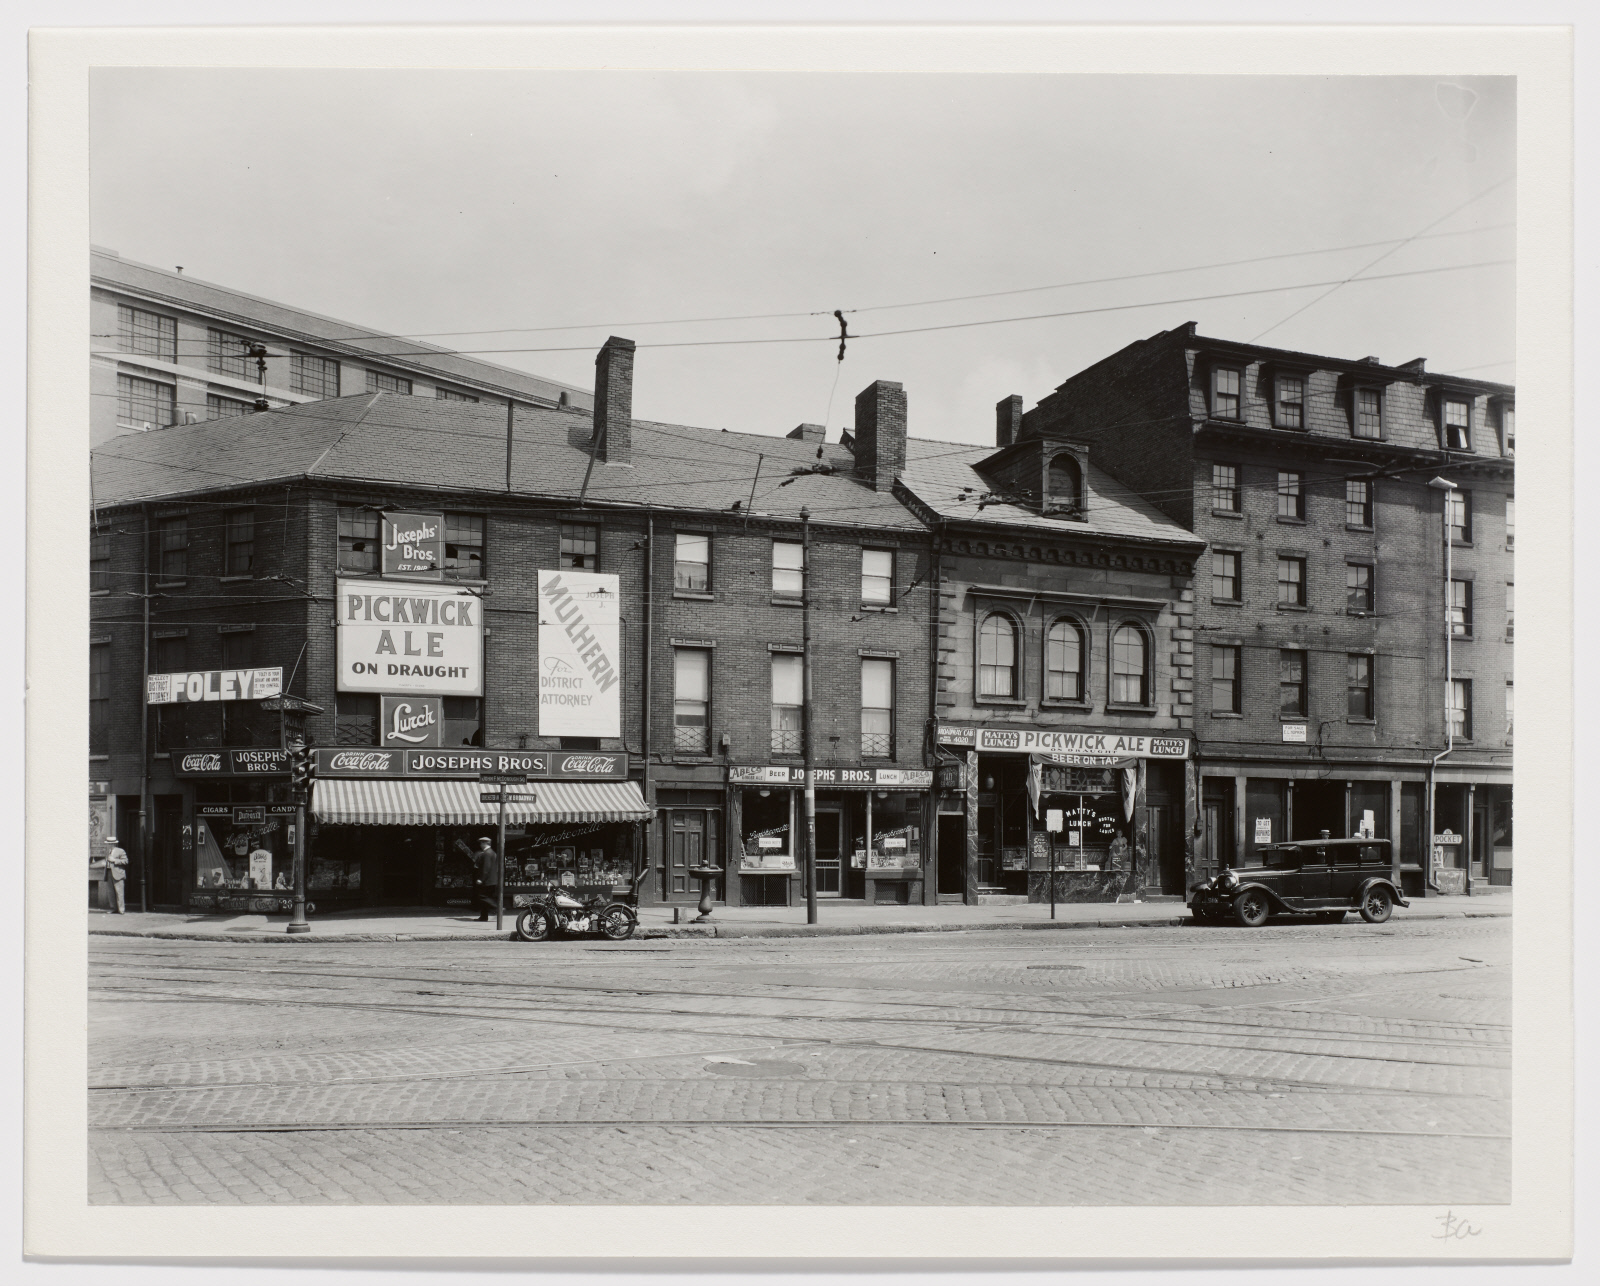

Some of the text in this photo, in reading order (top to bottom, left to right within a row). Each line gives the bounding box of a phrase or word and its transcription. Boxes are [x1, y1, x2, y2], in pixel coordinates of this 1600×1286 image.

[403, 545, 436, 560] Bros.
[586, 591, 614, 599] JOSEPH
[348, 594, 473, 626] PICKWICK
[541, 574, 618, 694] MULHERN
[375, 630, 444, 657] ALE
[352, 662, 469, 678] ON DRAUGHT
[544, 656, 574, 676] For
[149, 681, 168, 691] DISTRICT
[172, 671, 253, 702] FOLEY
[541, 676, 583, 689] DISTRICT
[541, 693, 593, 707] ATTORNEY
[387, 703, 435, 742] Lunch
[985, 731, 1018, 739] MATTY'S
[1025, 732, 1144, 751] PICKWICK ALE
[984, 739, 1017, 747] LUNCH
[1153, 746, 1183, 754] LUNCH
[182, 754, 221, 771] Coca-Cola
[247, 763, 280, 771] BROS.
[330, 752, 392, 770] Coca-Cola
[412, 755, 546, 770] JOSEPHS BROS.
[561, 756, 617, 772] Coca-Cola
[1052, 754, 1119, 765] BEER ON TAP
[792, 769, 873, 781] JOEPHS BROS.
[1066, 808, 1096, 817] MATTY'S
